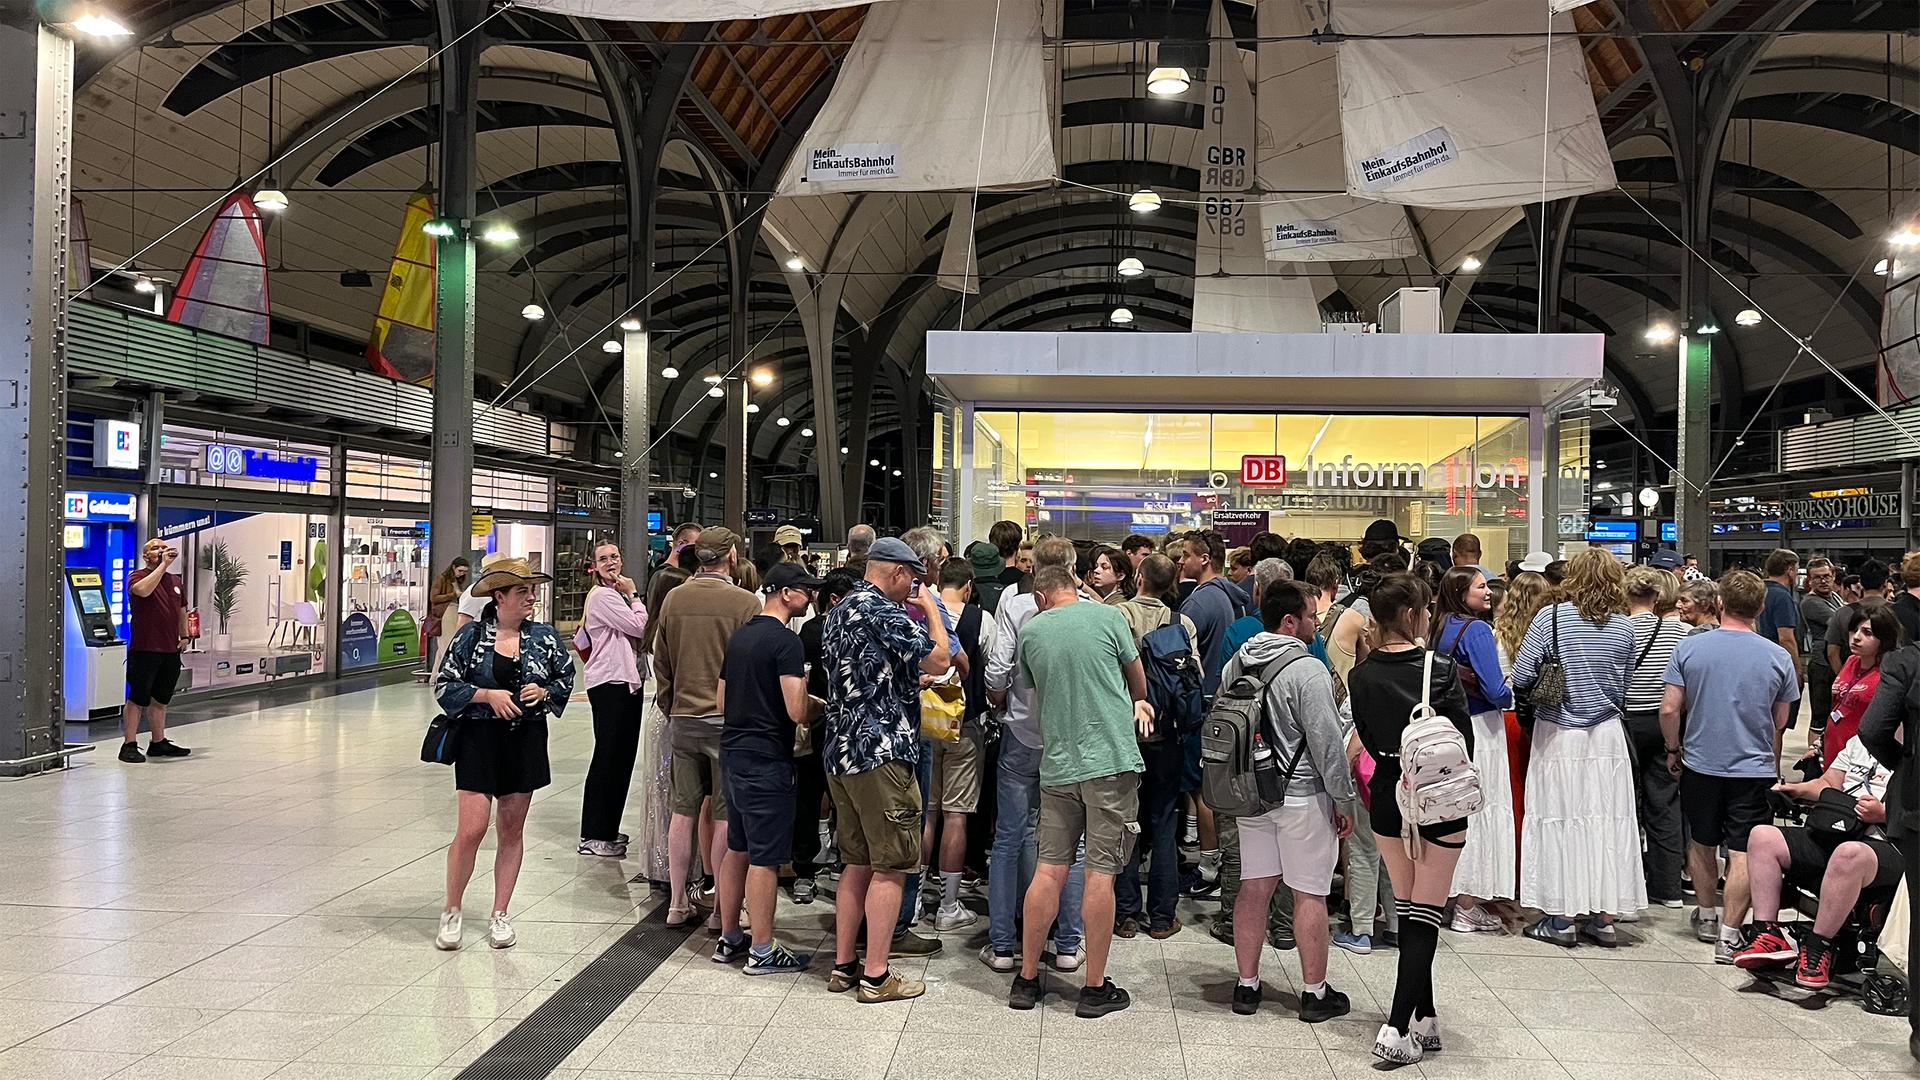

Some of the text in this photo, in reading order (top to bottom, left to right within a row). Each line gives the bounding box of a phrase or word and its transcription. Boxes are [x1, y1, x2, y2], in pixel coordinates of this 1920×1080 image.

[1213, 86, 1225, 104] D
[812, 155, 895, 170] EinkaufsBahnhof
[1207, 146, 1246, 166] GBR
[1365, 141, 1448, 182] EinkaufsBahnhof
[1393, 169, 1413, 182] Immer
[1413, 164, 1424, 173] für
[1424, 158, 1442, 169] mich
[1205, 196, 1245, 217] 687
[1276, 229, 1337, 240] EinkaufsBahnhof
[1247, 454, 1520, 489] DB Information
[577, 490, 609, 510] BLUMEN
[1780, 493, 1898, 521] ESPRESSO HOUSE
[164, 522, 196, 536] kümmern
[196, 515, 211, 527] uns!
[1213, 511, 1261, 520] Ersatzverkehr
